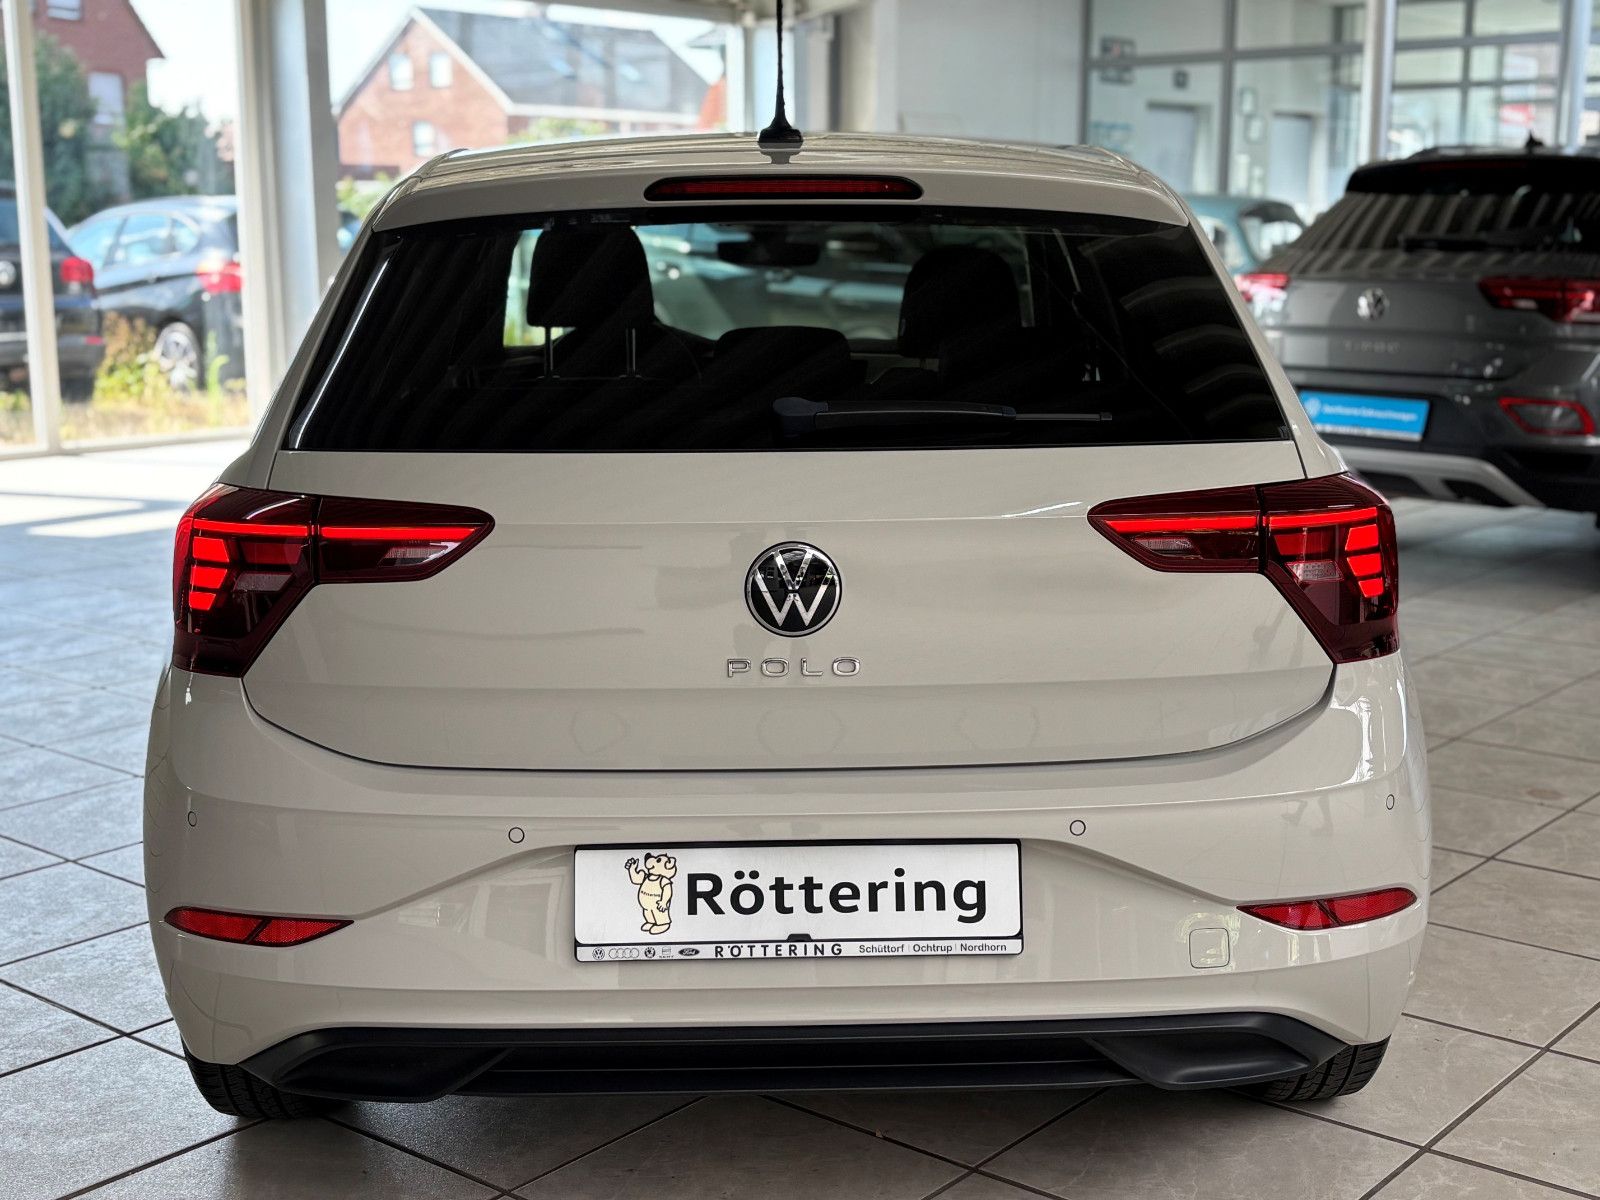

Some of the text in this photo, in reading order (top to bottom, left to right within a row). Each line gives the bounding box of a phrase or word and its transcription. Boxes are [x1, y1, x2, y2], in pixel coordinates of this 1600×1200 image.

[727, 657, 861, 678] POLO
[687, 867, 987, 924] Röttering
[715, 943, 843, 958] RÖTTERING
[858, 942, 1007, 955] Schüttorf Ochtrup Nordhorn
